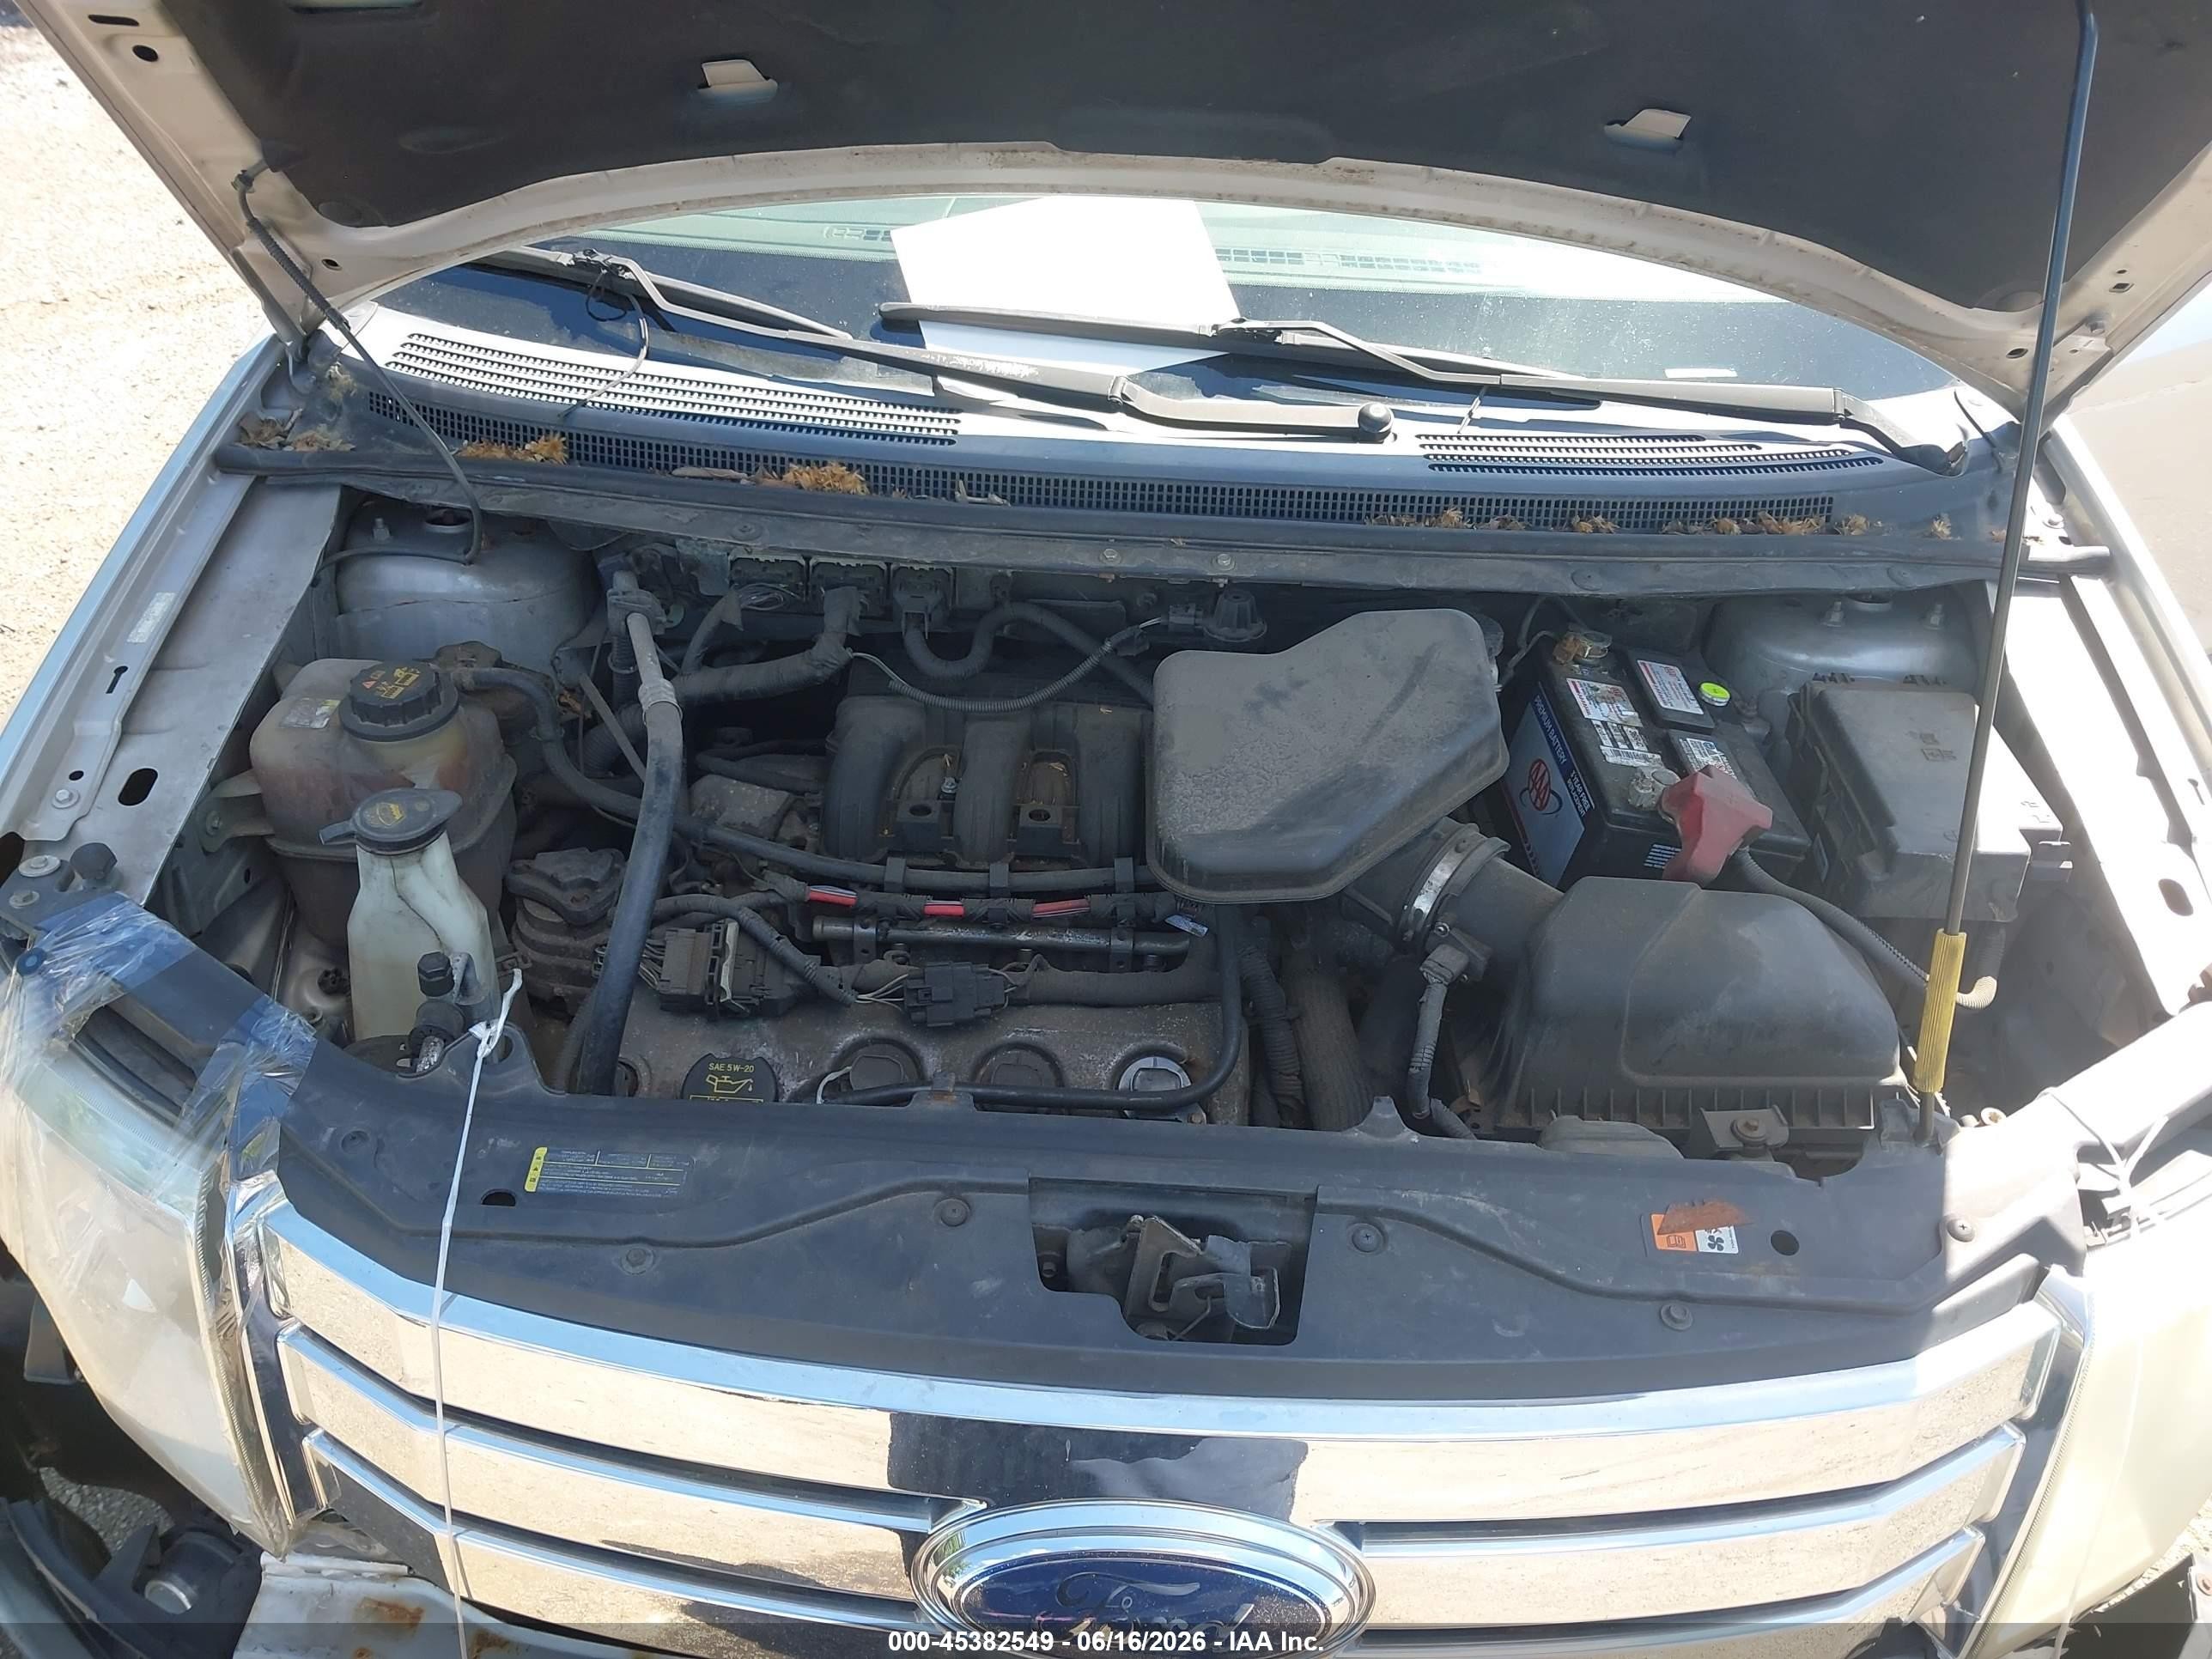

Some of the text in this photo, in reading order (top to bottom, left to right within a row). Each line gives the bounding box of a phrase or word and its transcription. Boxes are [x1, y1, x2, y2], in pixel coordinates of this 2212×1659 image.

[1548, 728, 1567, 764] BATTERY
[1580, 791, 1590, 812] FREE
[708, 1062, 755, 1073] SAE 5W-20
[1036, 1571, 1256, 1653] Ford
